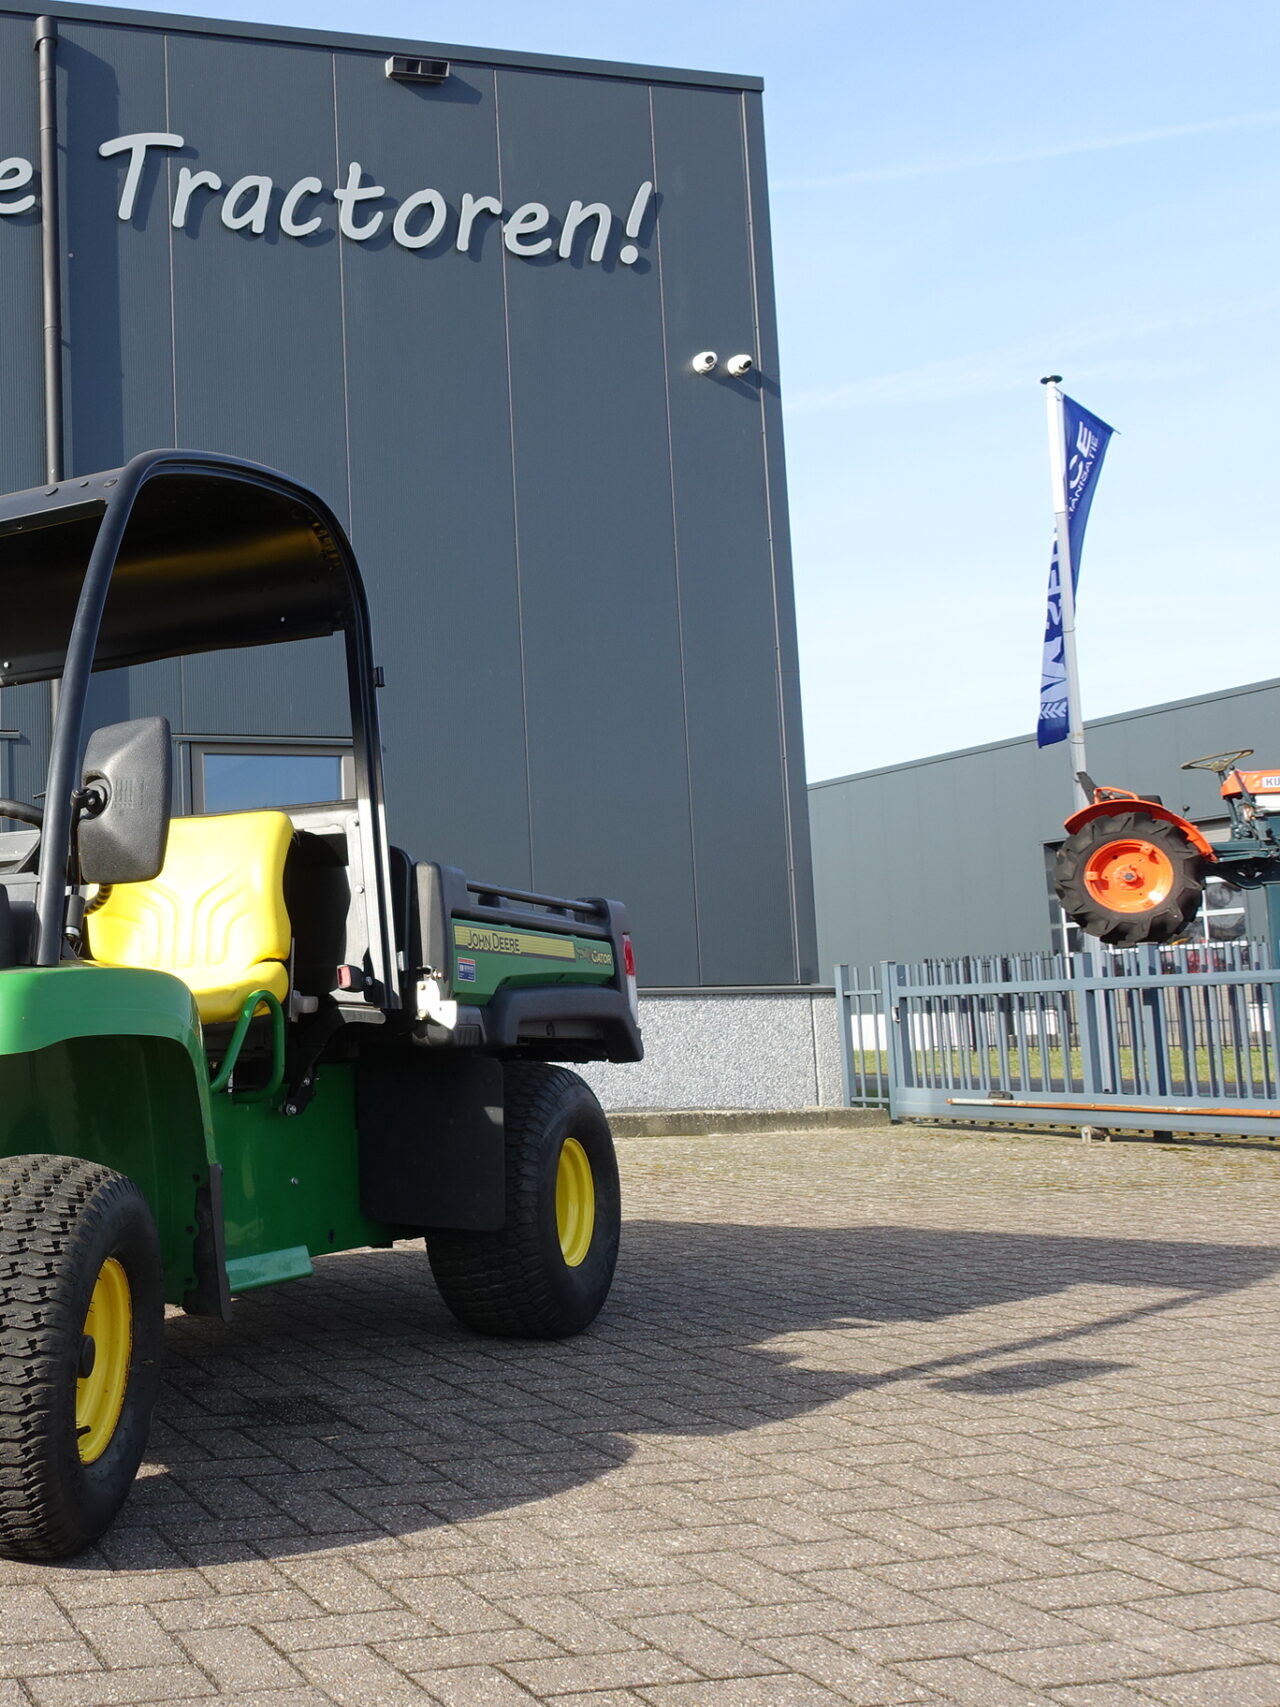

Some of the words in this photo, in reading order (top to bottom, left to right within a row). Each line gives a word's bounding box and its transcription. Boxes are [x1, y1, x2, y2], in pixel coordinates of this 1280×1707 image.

[98, 131, 653, 265] Tractoren!
[467, 930, 492, 949] JOHN
[492, 932, 521, 952] DEERE
